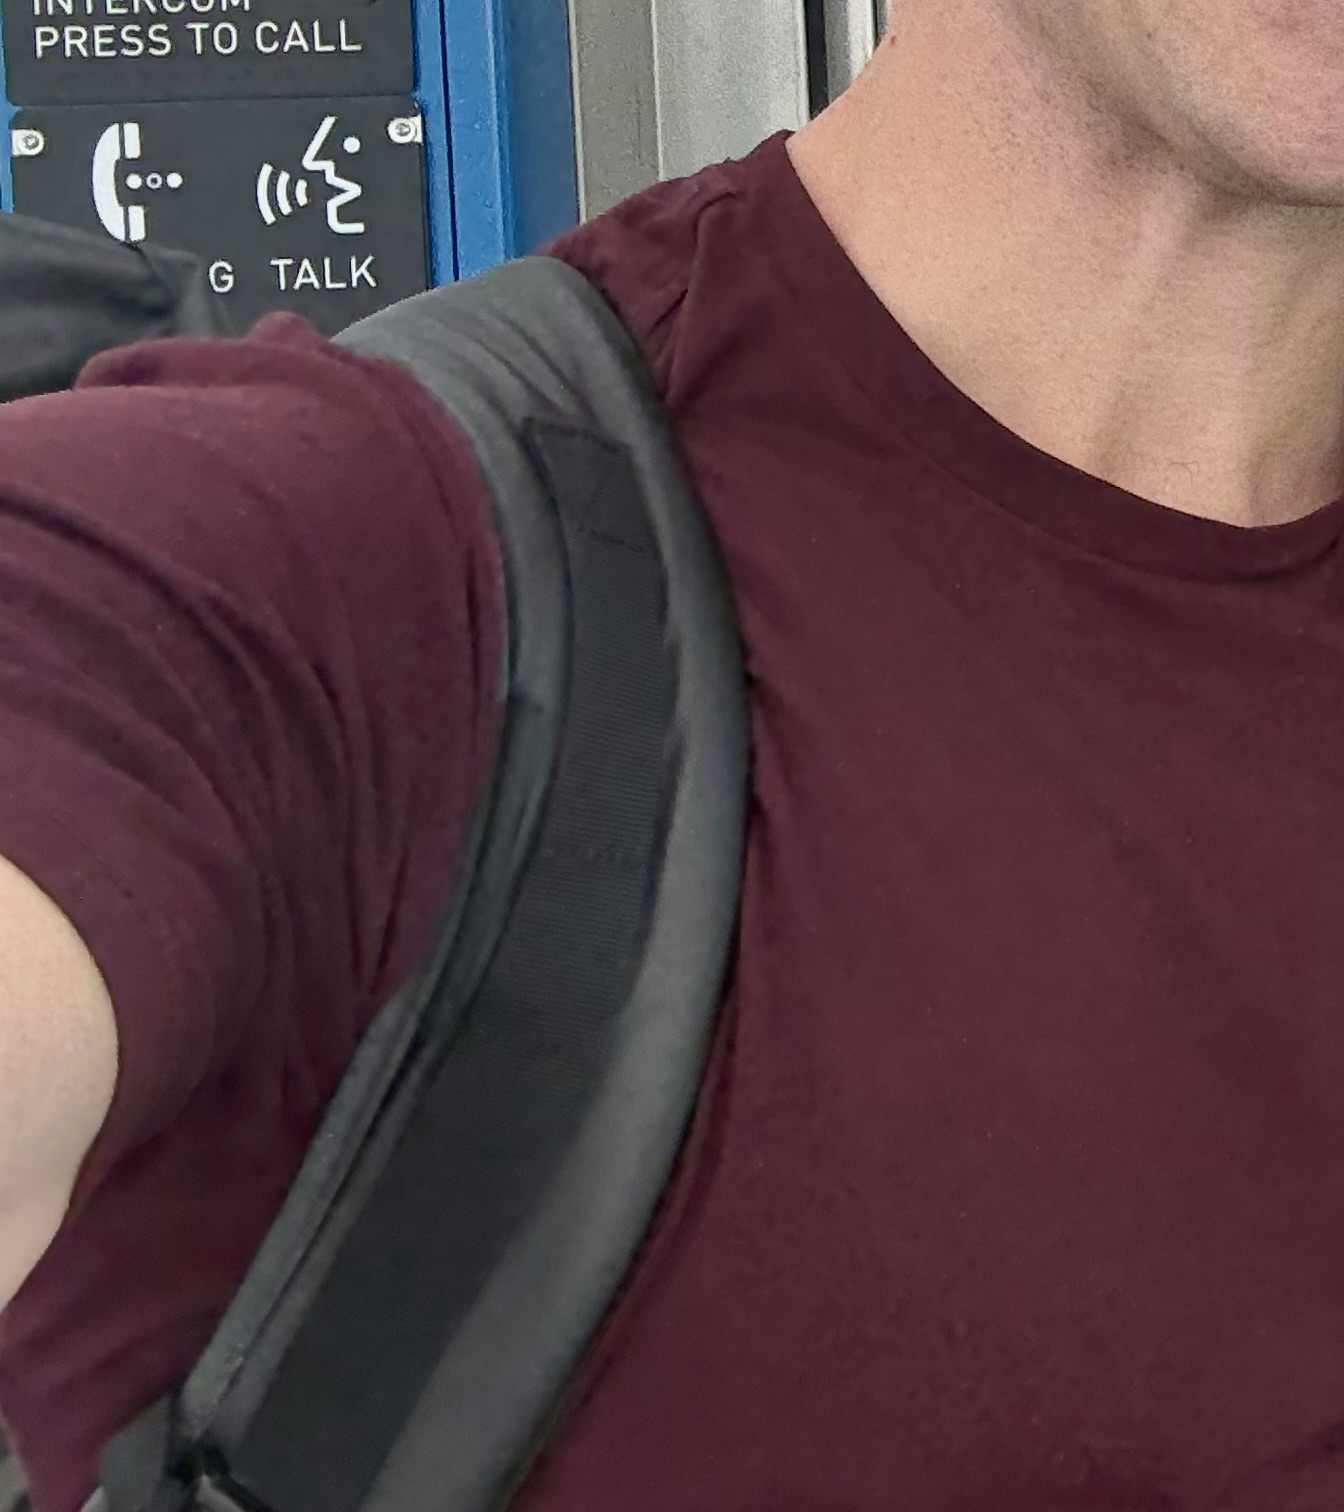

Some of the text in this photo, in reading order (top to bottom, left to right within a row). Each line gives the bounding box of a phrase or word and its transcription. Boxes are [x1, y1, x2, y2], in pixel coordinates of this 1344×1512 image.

[34, 18, 363, 59] PRESS TO CALL
[269, 254, 378, 291] TALK
